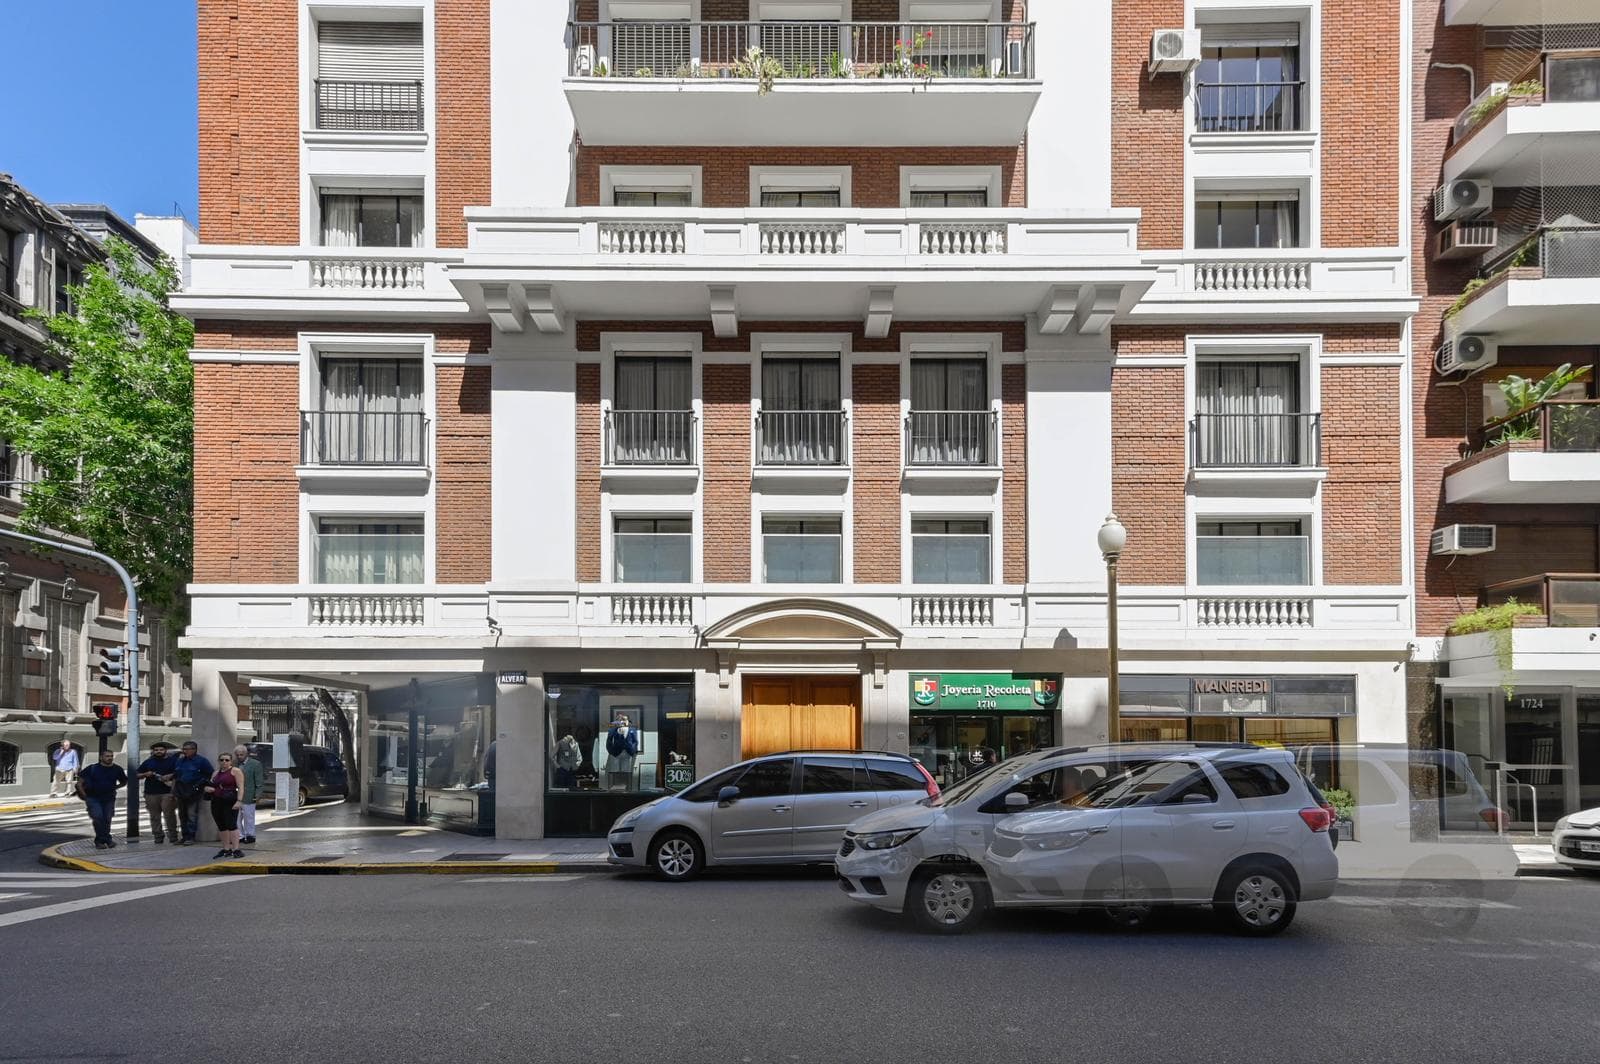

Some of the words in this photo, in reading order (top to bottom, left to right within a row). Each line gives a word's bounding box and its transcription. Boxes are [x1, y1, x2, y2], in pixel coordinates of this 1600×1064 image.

[501, 675, 525, 683] ALVEAR
[941, 685, 982, 697] Joyeria
[984, 685, 1032, 698] Recoleta
[1195, 680, 1268, 693] MANFREDI
[977, 700, 997, 708] 1710
[1520, 698, 1543, 708] 1724
